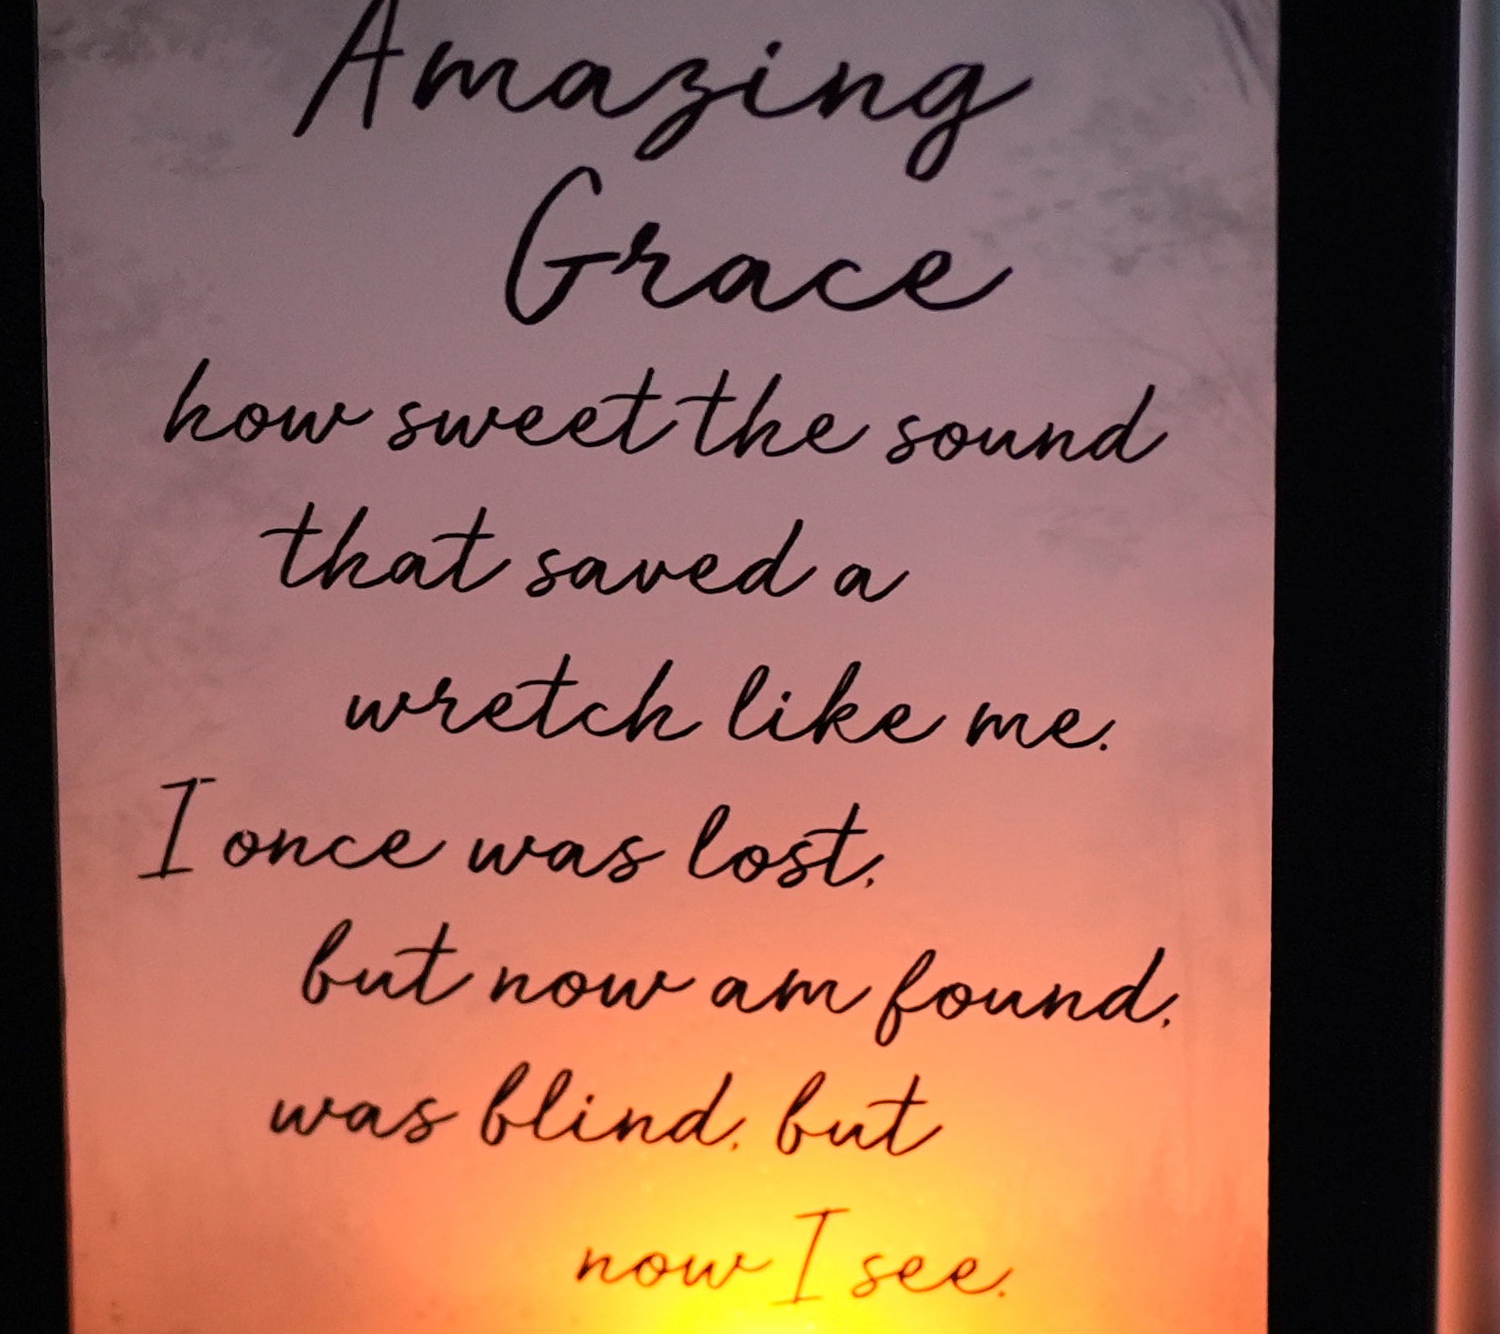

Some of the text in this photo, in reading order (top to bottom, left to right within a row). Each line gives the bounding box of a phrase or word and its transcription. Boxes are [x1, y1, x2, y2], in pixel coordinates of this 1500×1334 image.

[504, 165, 1014, 326] Grace
[163, 358, 1168, 465] how sweet the sound
[259, 502, 910, 603] that saved a
[344, 653, 1116, 751] wretch like me.
[136, 777, 217, 880] I
[222, 828, 447, 870] once
[467, 835, 666, 884] was
[301, 918, 475, 1006] but
[489, 966, 696, 1011] now
[710, 968, 873, 1014] am
[269, 1096, 459, 1144] was
[775, 1070, 944, 1157] but
[575, 1208, 1013, 1304] now I see.
